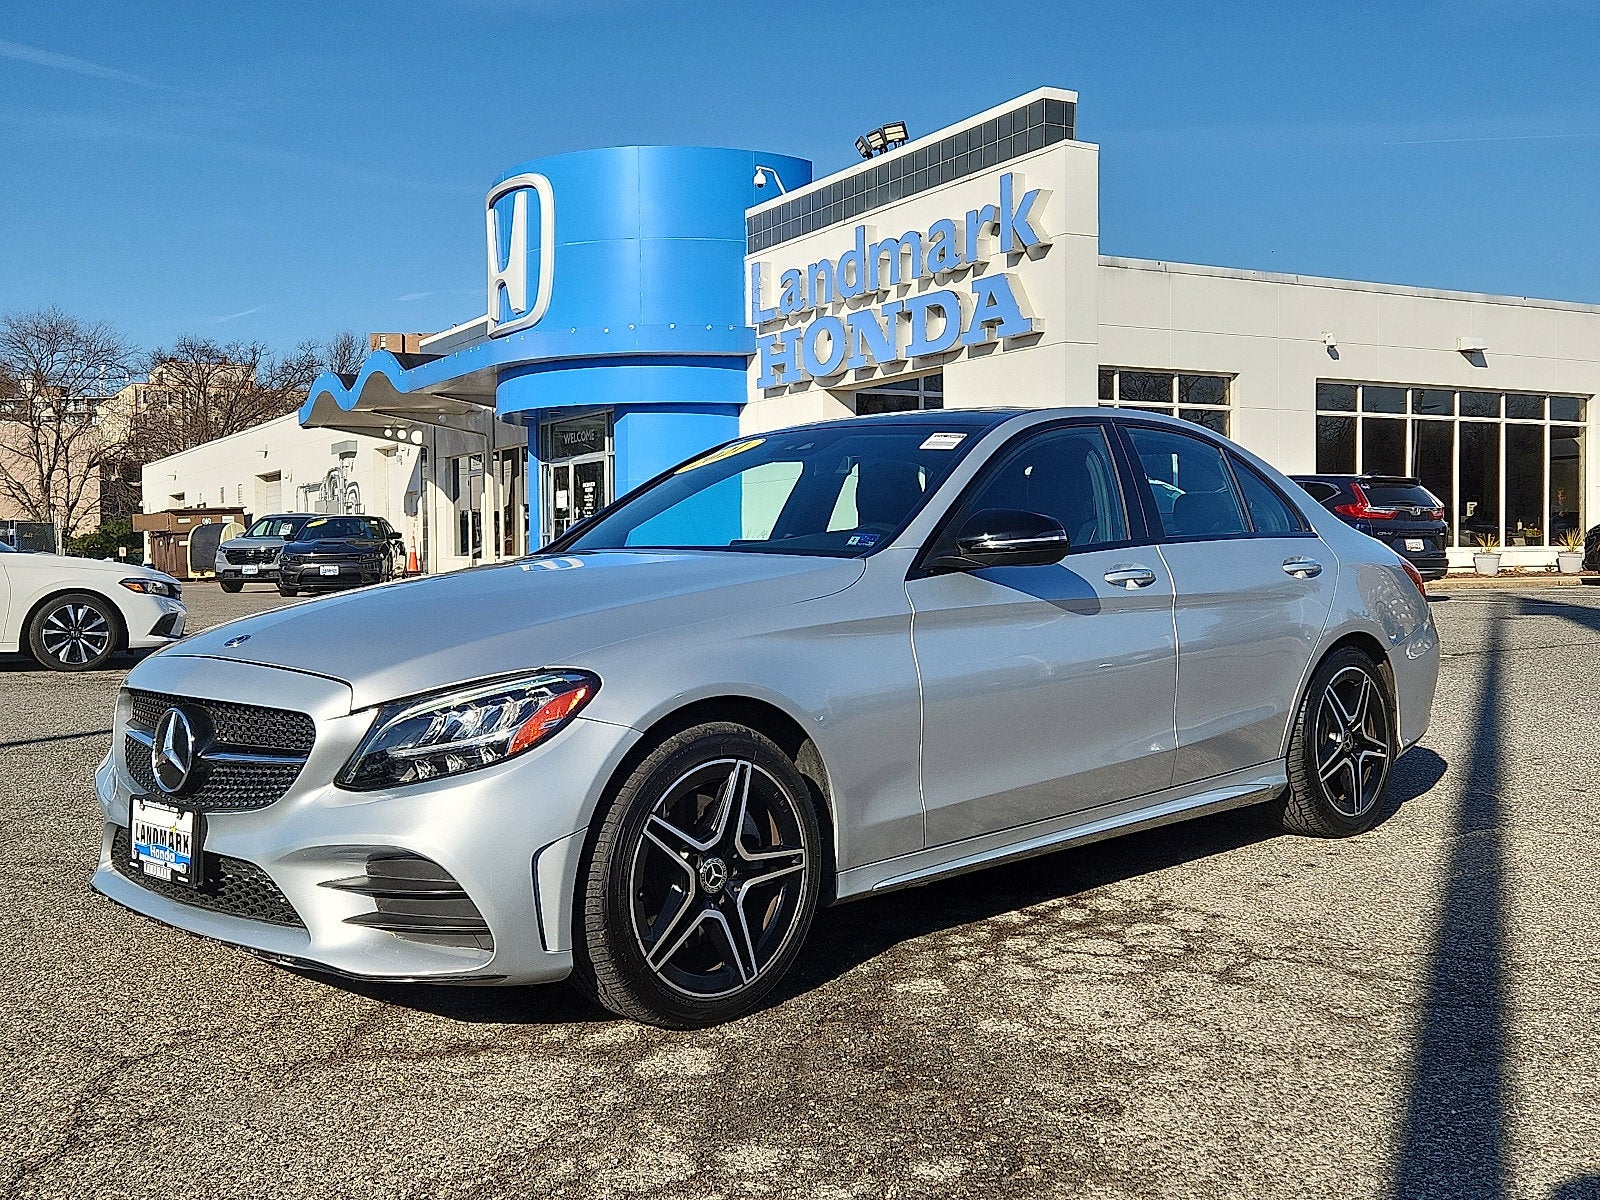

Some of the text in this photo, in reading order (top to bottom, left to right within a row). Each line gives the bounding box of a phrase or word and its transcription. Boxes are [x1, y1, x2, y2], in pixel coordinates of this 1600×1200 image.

[751, 172, 1041, 326] Landmark
[756, 272, 1033, 389] HONDA
[563, 429, 595, 445] WELCOME
[135, 822, 190, 854] LANDMARK
[150, 844, 176, 863] Honda
